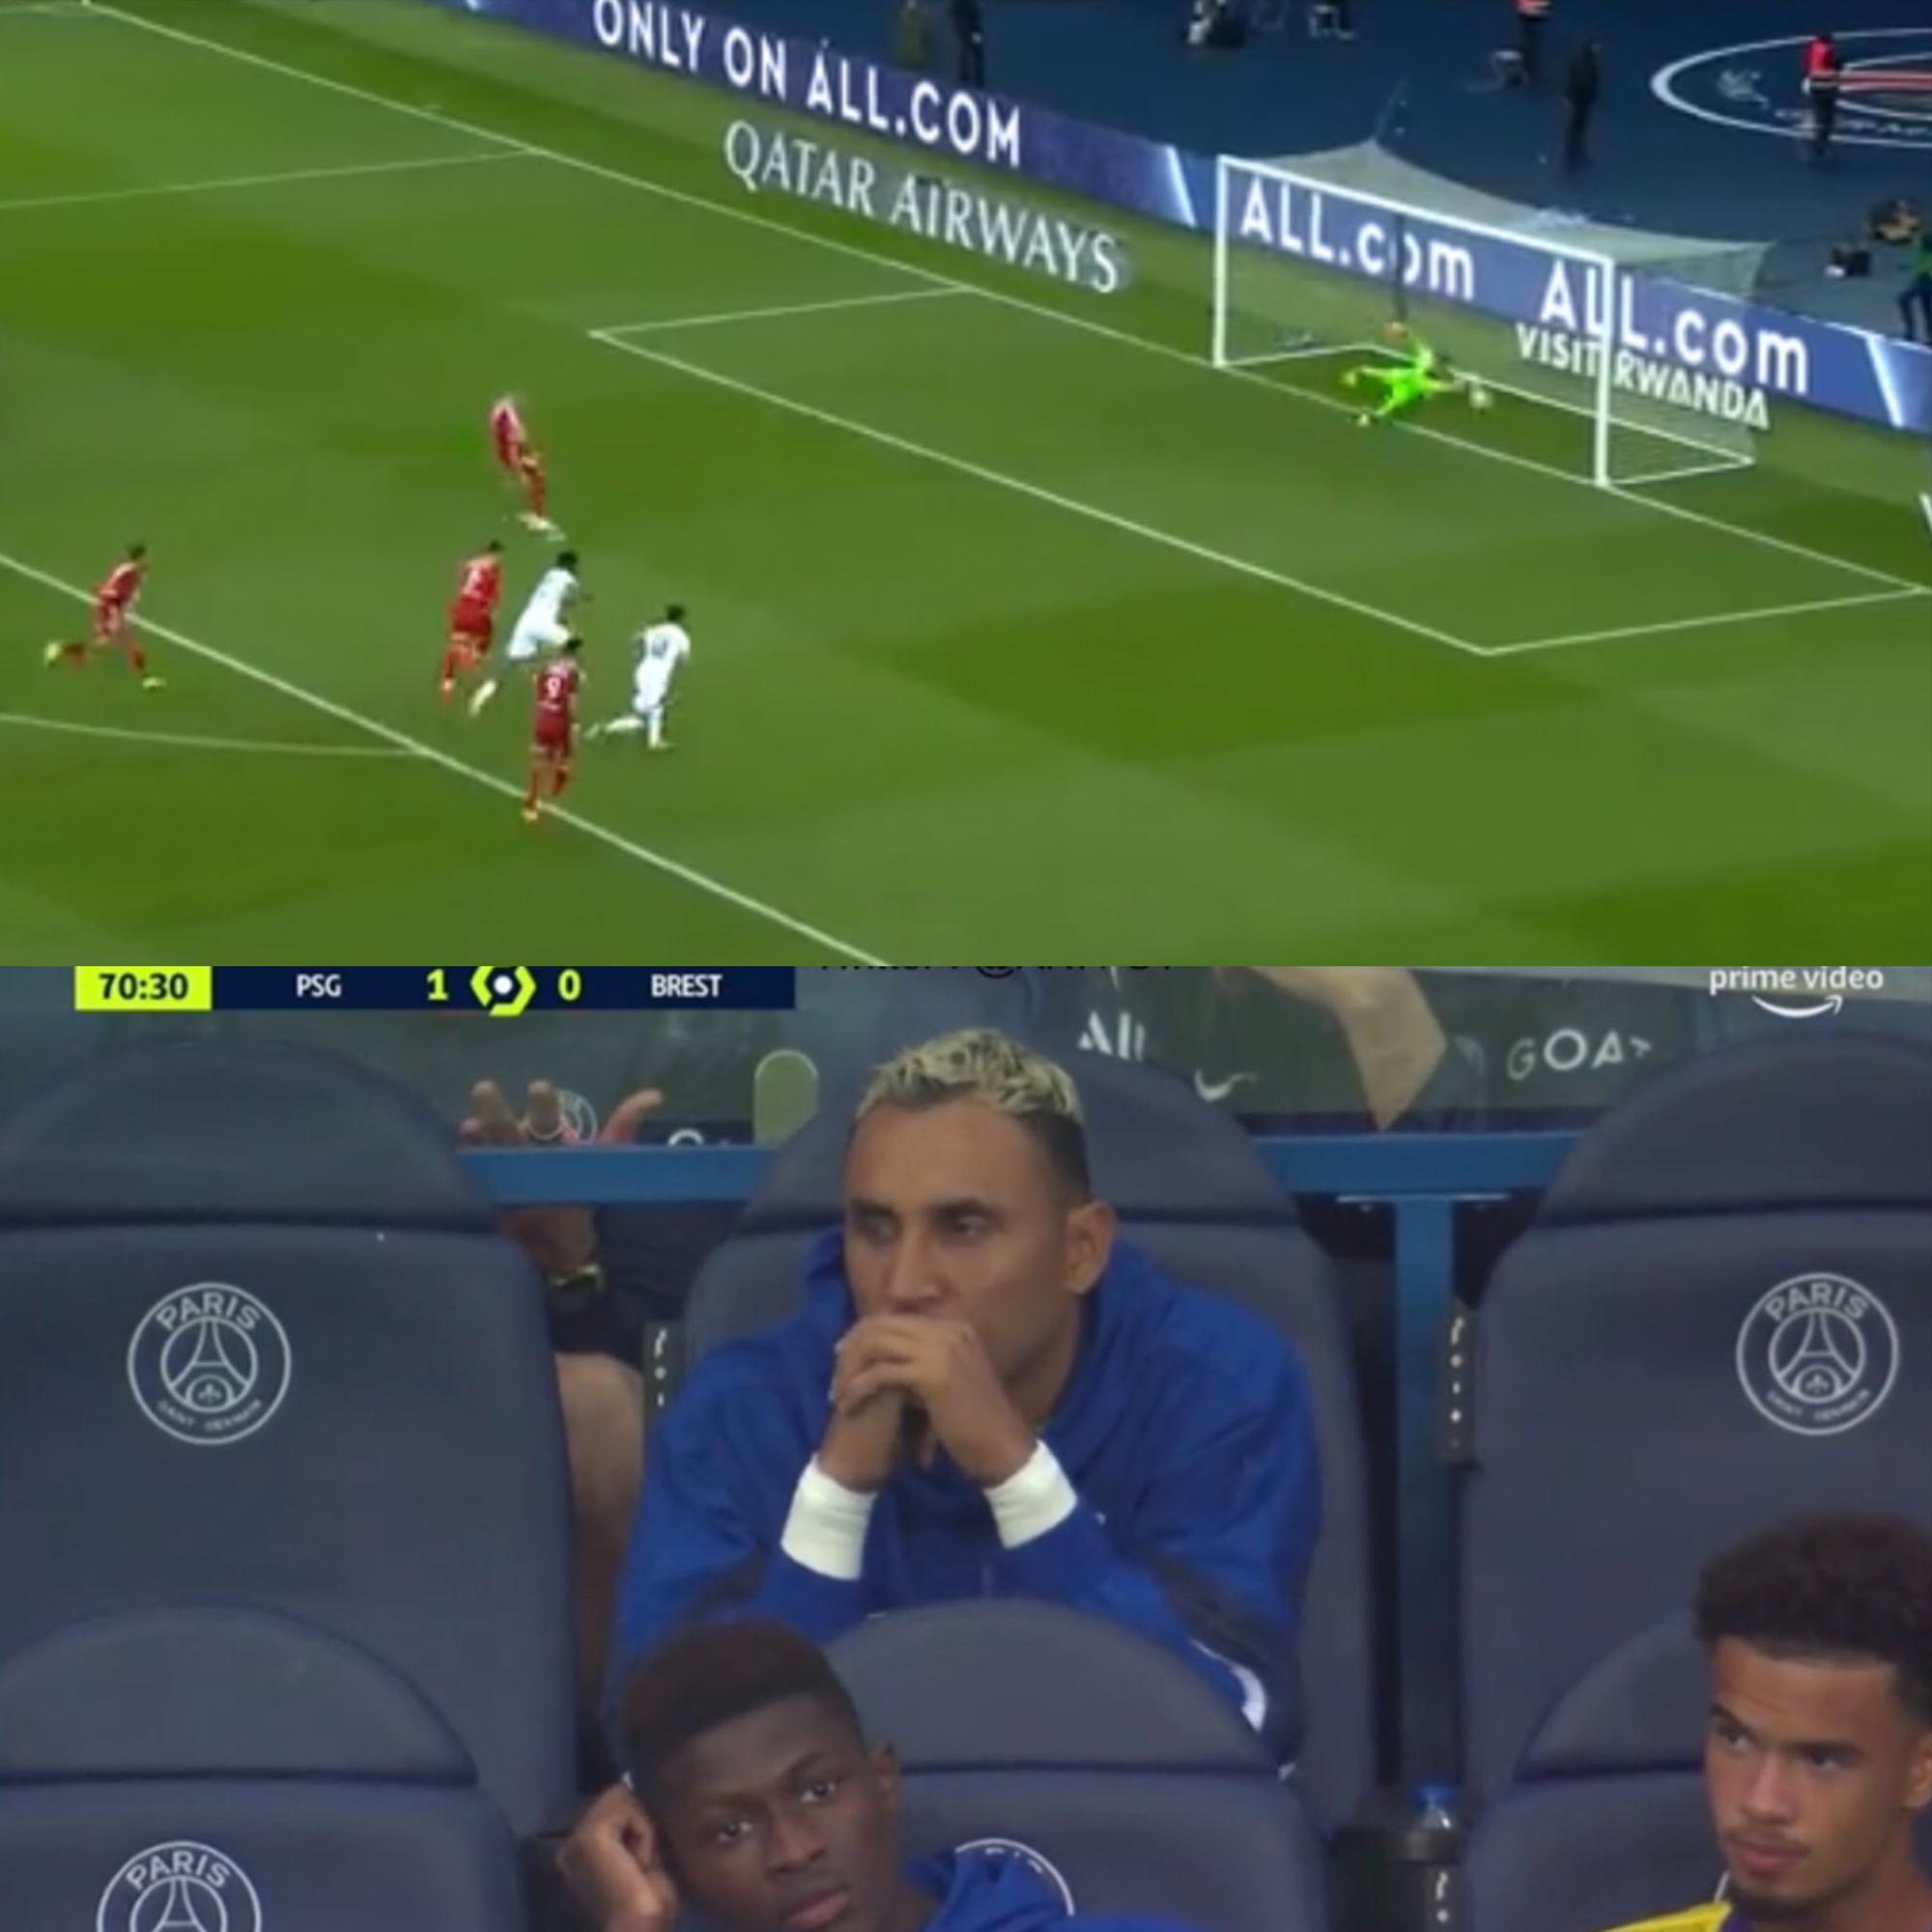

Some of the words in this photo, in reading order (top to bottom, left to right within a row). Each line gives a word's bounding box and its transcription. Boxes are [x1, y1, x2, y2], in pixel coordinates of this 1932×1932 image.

[594, 0, 704, 71] ONLY
[724, 27, 786, 99] ON
[807, 48, 1020, 166] ALL.COM
[725, 120, 875, 218] QATAR
[890, 174, 1120, 293] AIRWAYS
[1516, 322, 1603, 378] VISIT
[1613, 348, 1771, 431] RWANDA
[156, 1291, 262, 1331] PARIS
[1765, 1281, 1870, 1322] PARIS
[125, 1849, 231, 1891] PARIS
